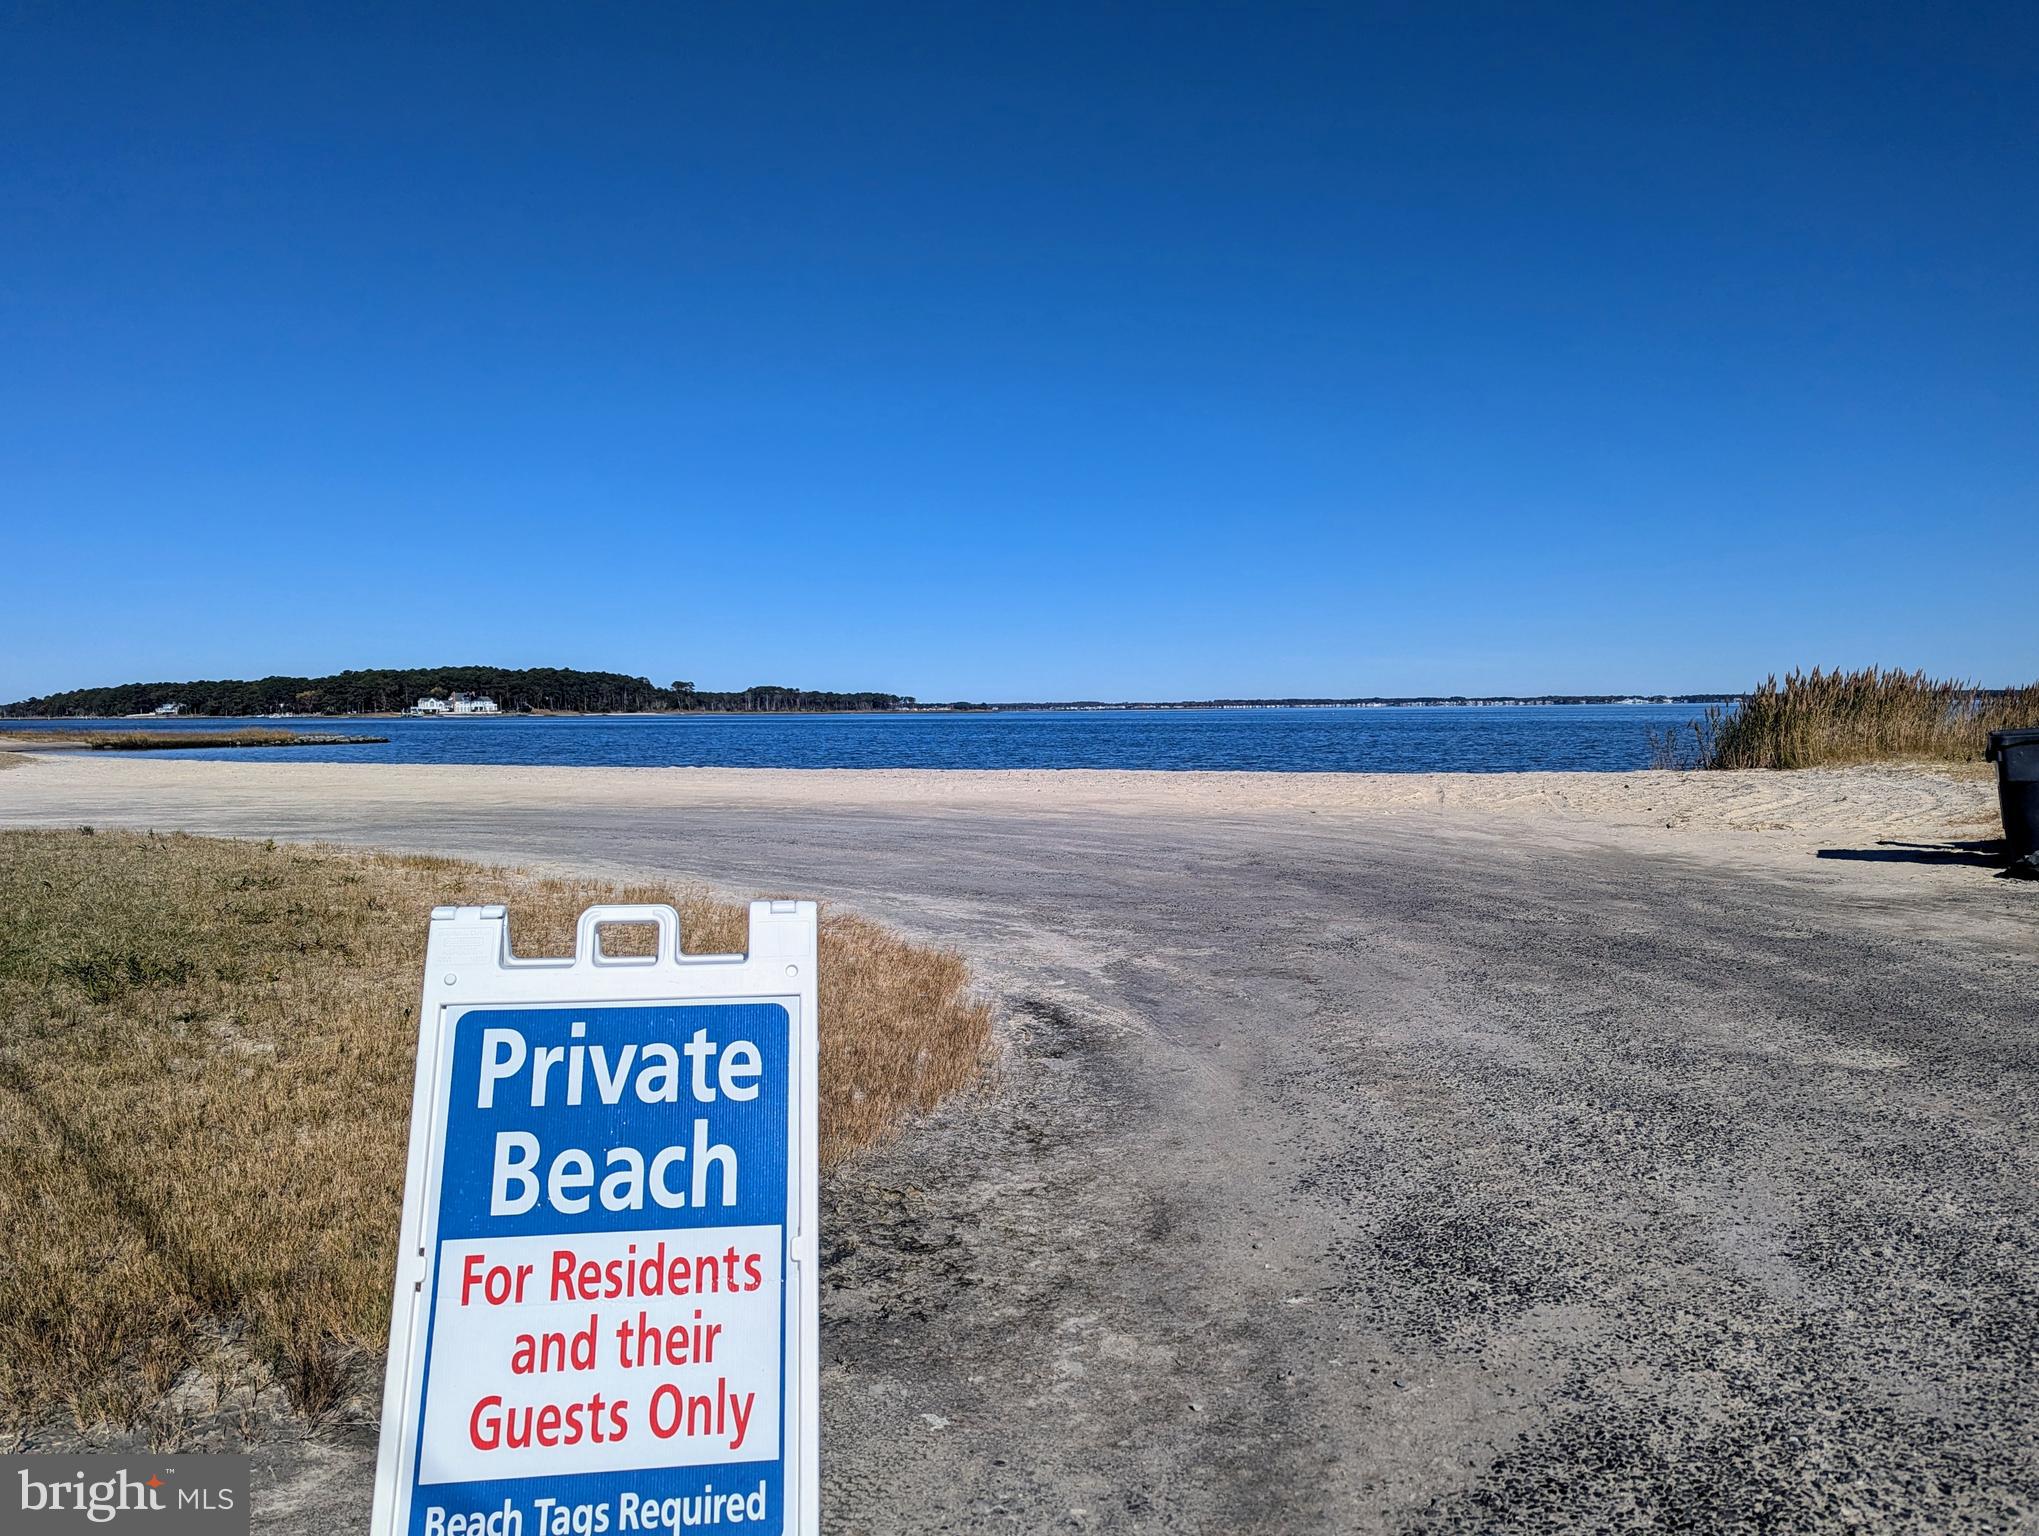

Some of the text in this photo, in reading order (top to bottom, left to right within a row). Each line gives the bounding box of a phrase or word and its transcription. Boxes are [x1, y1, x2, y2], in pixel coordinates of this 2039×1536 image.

[477, 1022, 762, 1108] Private
[490, 1119, 738, 1216] Beach
[461, 1242, 762, 1305] For Residents
[511, 1309, 722, 1375] and their
[469, 1377, 755, 1450] Guests Only
[424, 1480, 767, 1536] Beach Tags Required
